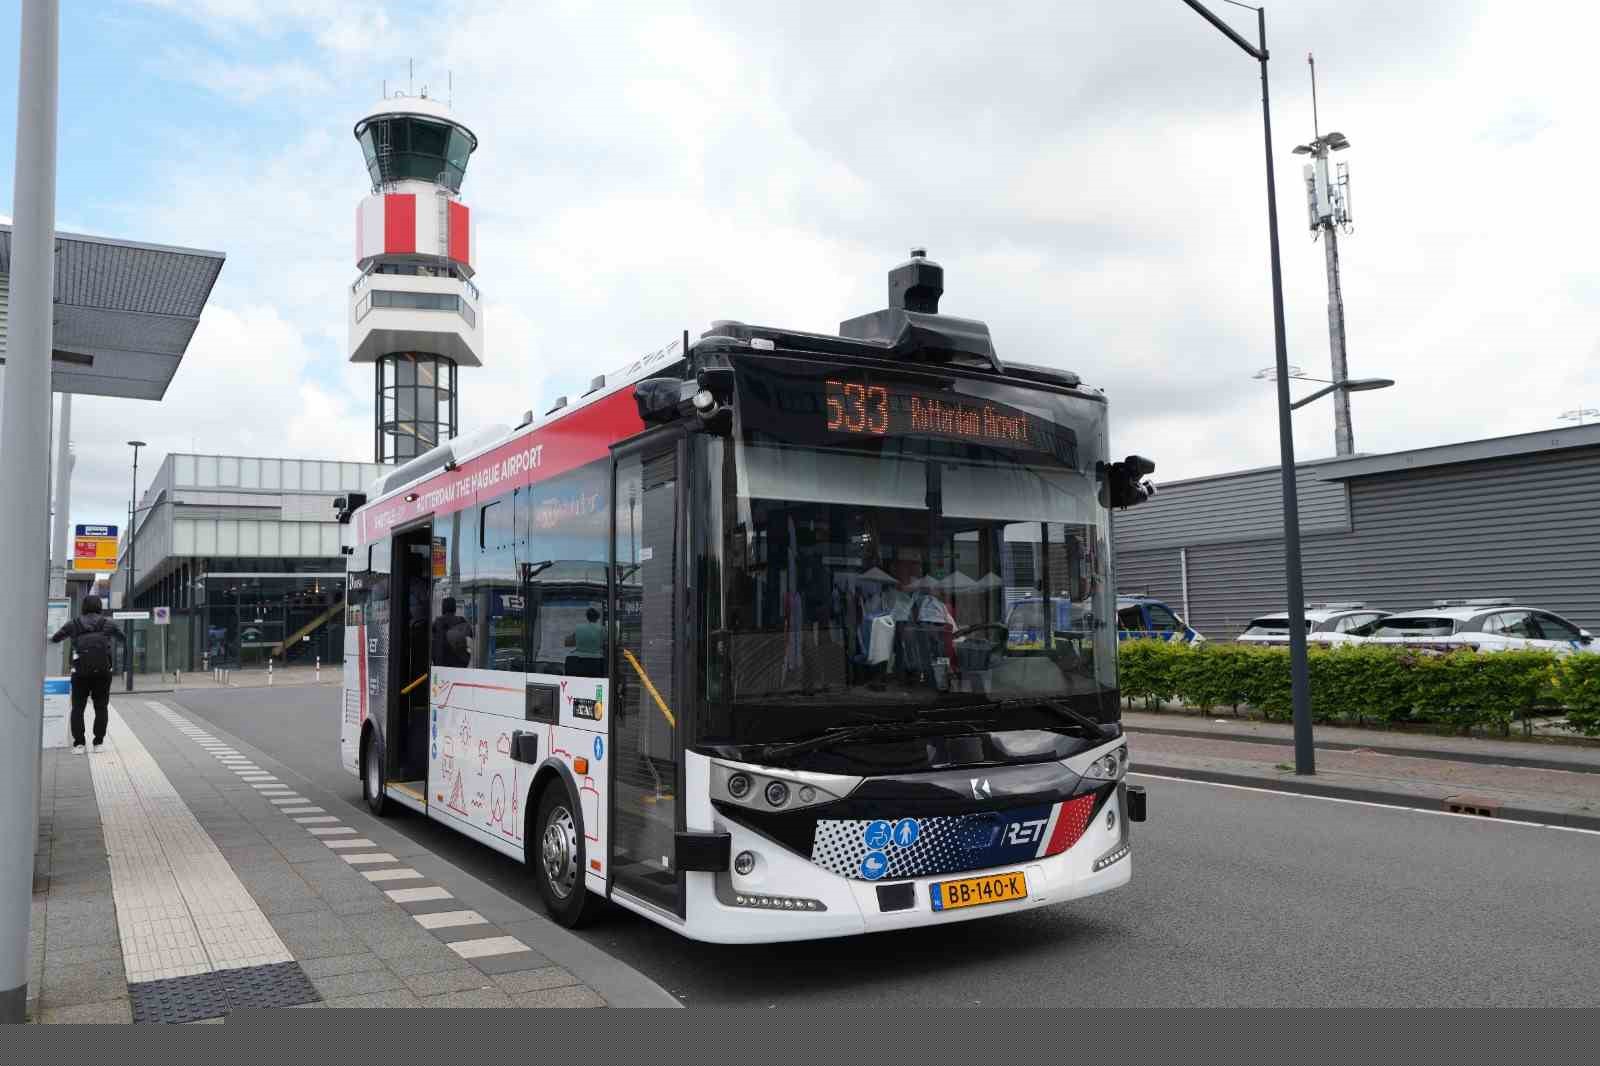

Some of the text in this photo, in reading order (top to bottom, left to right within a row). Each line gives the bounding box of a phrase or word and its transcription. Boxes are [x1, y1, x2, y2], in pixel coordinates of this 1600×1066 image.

[825, 379, 889, 435] 533
[454, 477, 471, 499] THE
[471, 463, 500, 493] HAGUE
[500, 444, 543, 481] AIRPORT
[1008, 818, 1049, 845] RET
[948, 877, 1020, 905] BB-140-K
